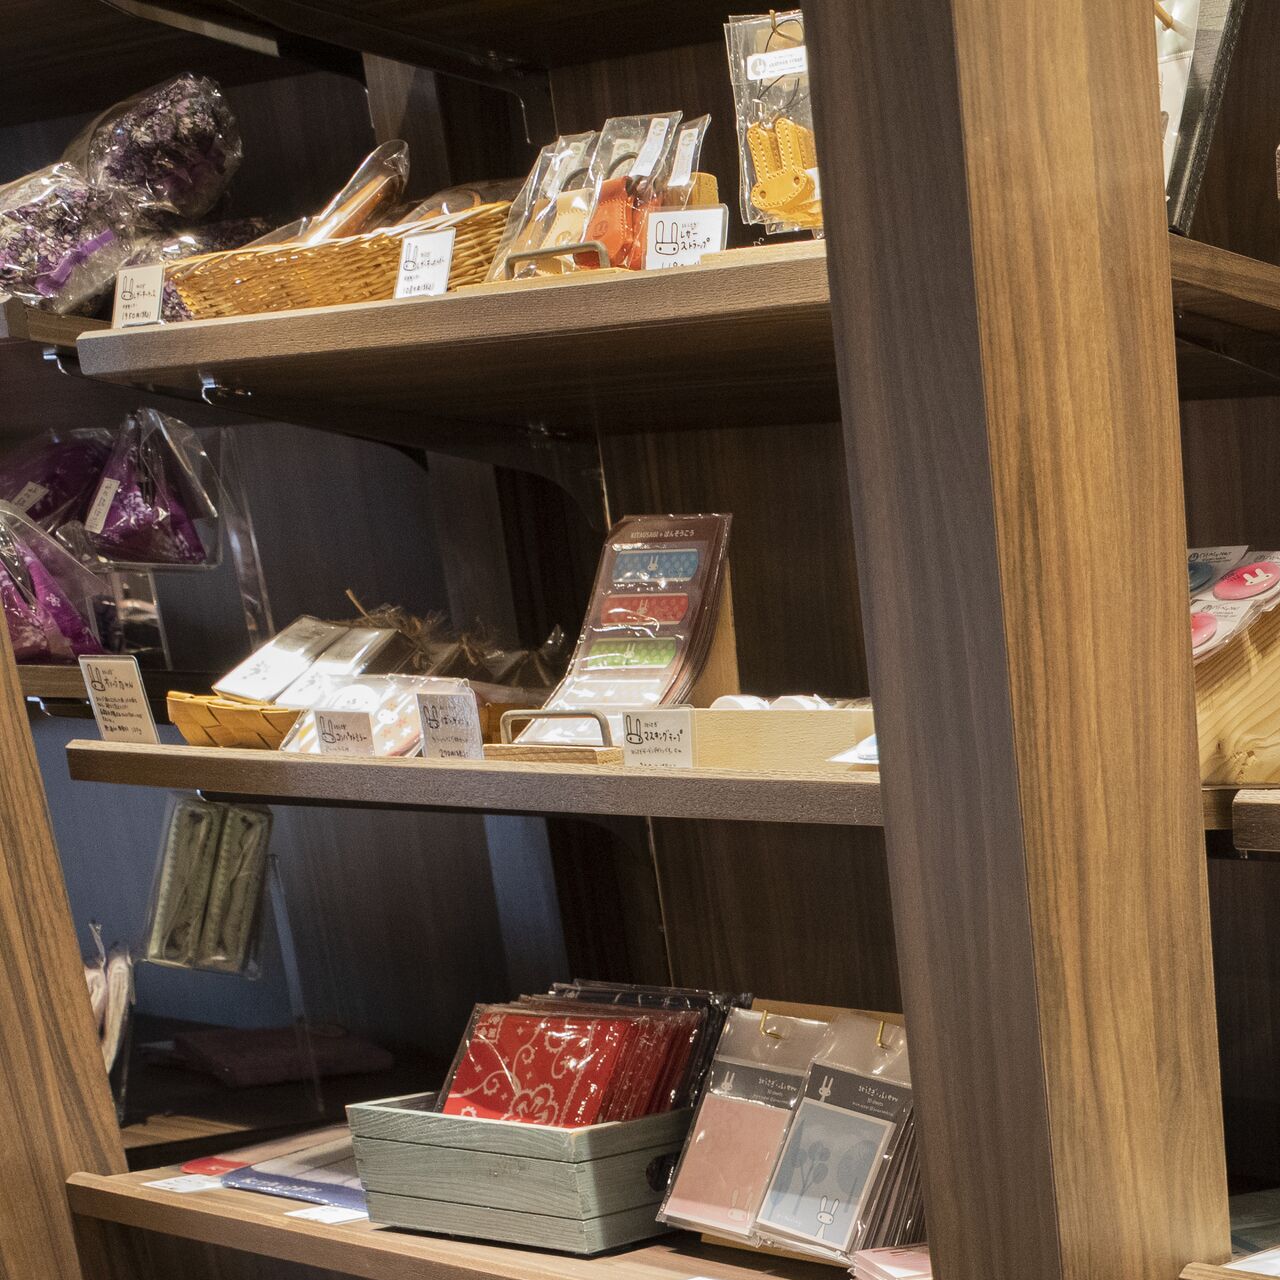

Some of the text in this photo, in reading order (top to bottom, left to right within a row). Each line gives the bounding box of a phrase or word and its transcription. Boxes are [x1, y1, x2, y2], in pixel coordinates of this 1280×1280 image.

[681, 237, 711, 251] ストラップ
